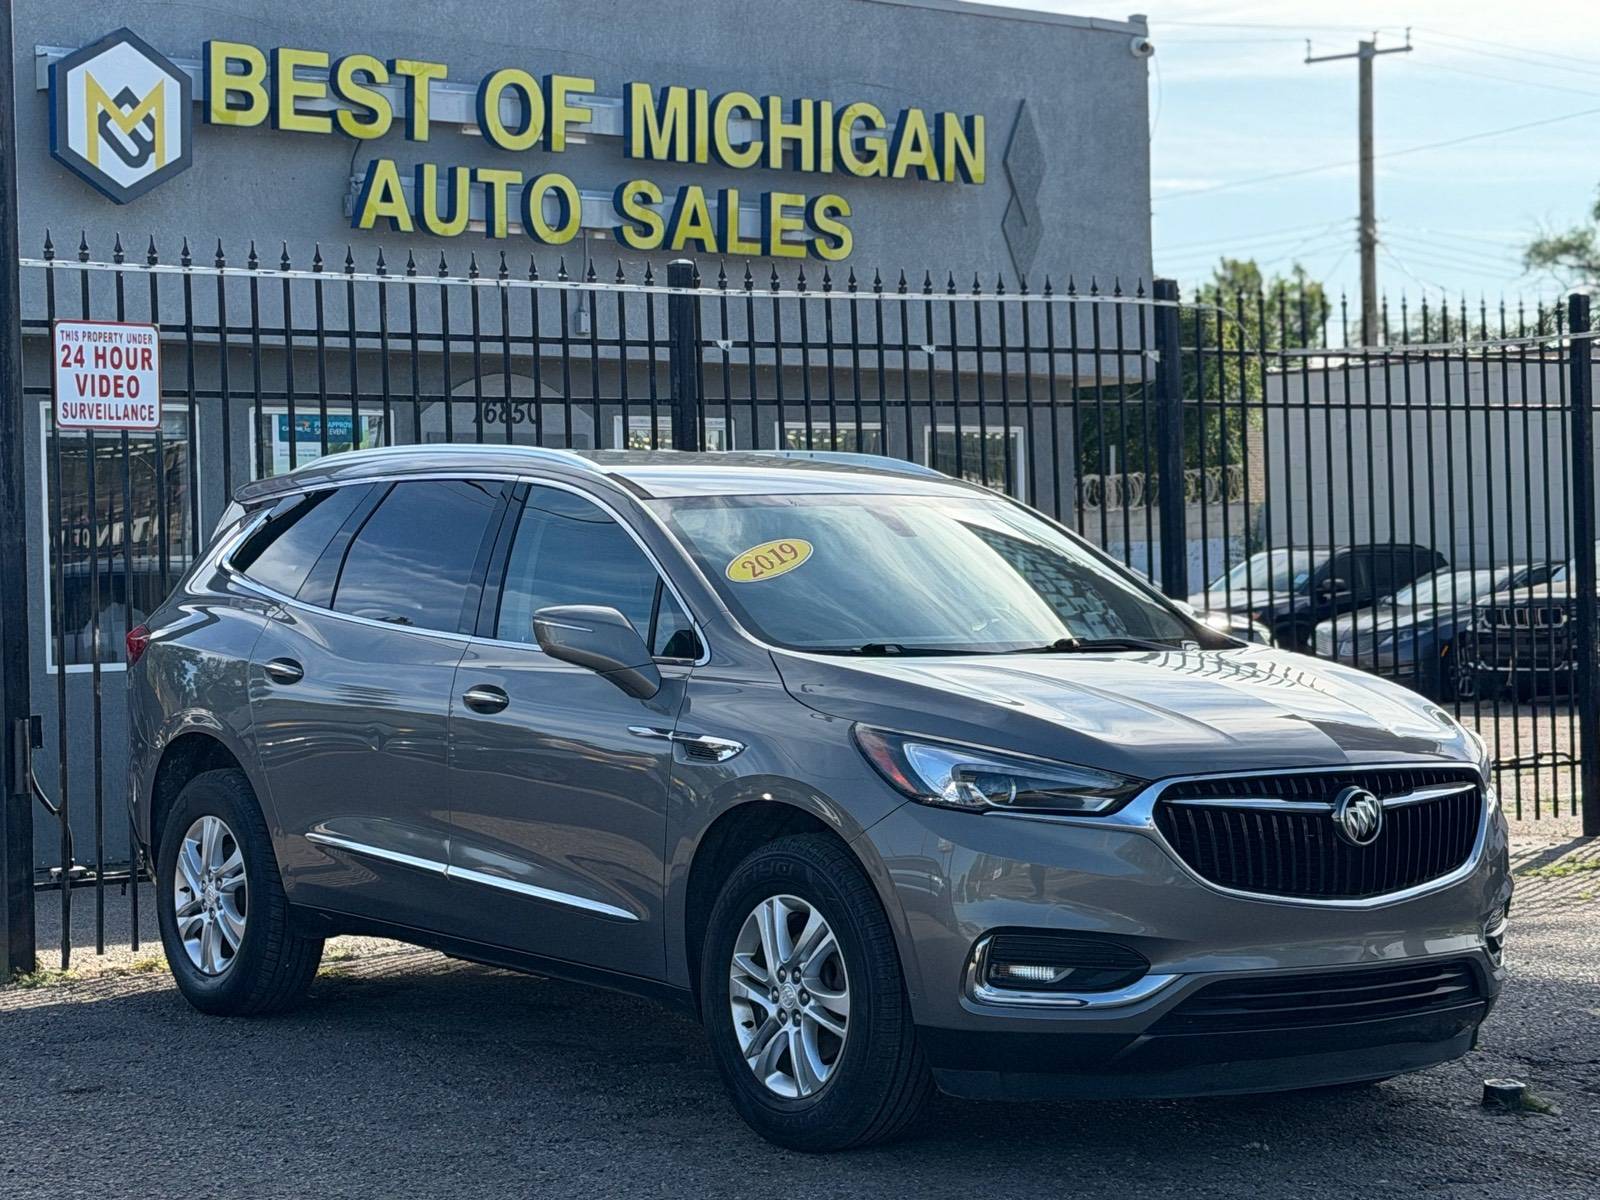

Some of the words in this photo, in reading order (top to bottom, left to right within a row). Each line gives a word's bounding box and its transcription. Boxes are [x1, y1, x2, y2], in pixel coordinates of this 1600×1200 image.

[203, 40, 447, 141] BEST
[477, 69, 596, 152] OF
[624, 82, 986, 185] MICHIGAN
[352, 159, 582, 245] AUTO
[614, 180, 854, 261] SALES
[60, 330, 79, 342] THIS
[82, 331, 123, 344] PROPERTY
[126, 333, 153, 345] UNDER
[61, 344, 85, 368] 24
[94, 345, 153, 371] HOUR
[75, 373, 140, 399] VIDEO
[62, 402, 155, 421] SURVEILLANCE
[472, 399, 540, 424] 6850
[741, 543, 799, 578] 2019
